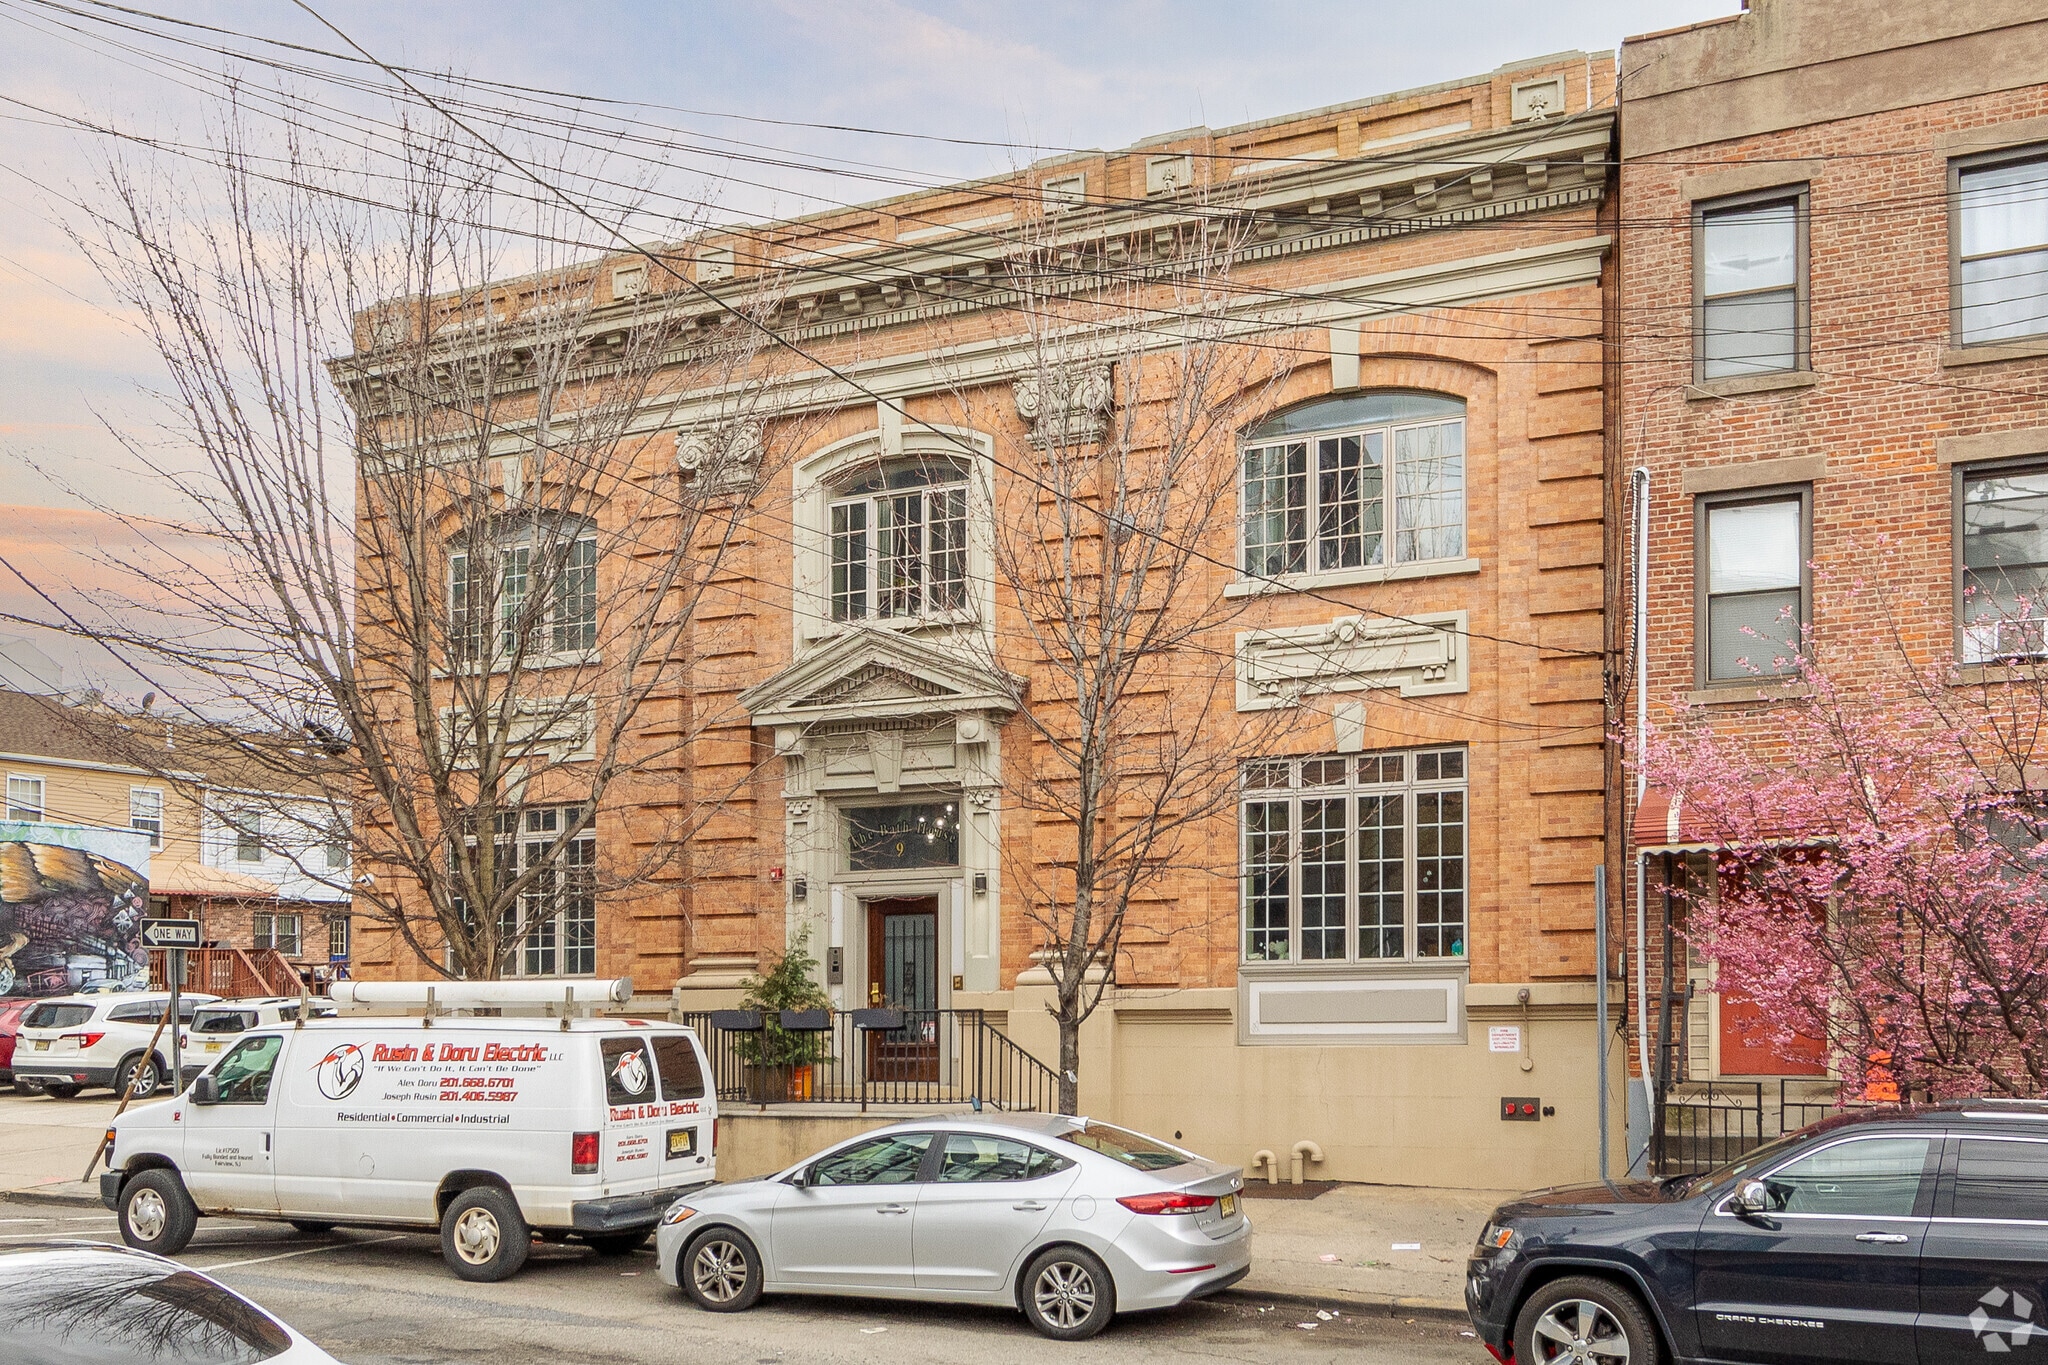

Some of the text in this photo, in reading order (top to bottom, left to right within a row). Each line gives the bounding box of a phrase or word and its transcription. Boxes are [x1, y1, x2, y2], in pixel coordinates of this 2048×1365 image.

[848, 821, 957, 848] The Bath House
[896, 842, 905, 857] 9
[154, 928, 192, 939] ONE WAY
[372, 1043, 564, 1062] Rusin & Doru Electric LLC
[397, 1077, 515, 1088] Alex Doru 201.668.6701
[382, 1091, 518, 1102] Joseph Rusin 201.406.5987
[337, 1112, 510, 1124] Residential Commercial Industrial
[610, 1106, 635, 1122] Rusin
[670, 1101, 699, 1116] Electric
[1716, 1314, 1824, 1328] GRAND CHEROKEE
